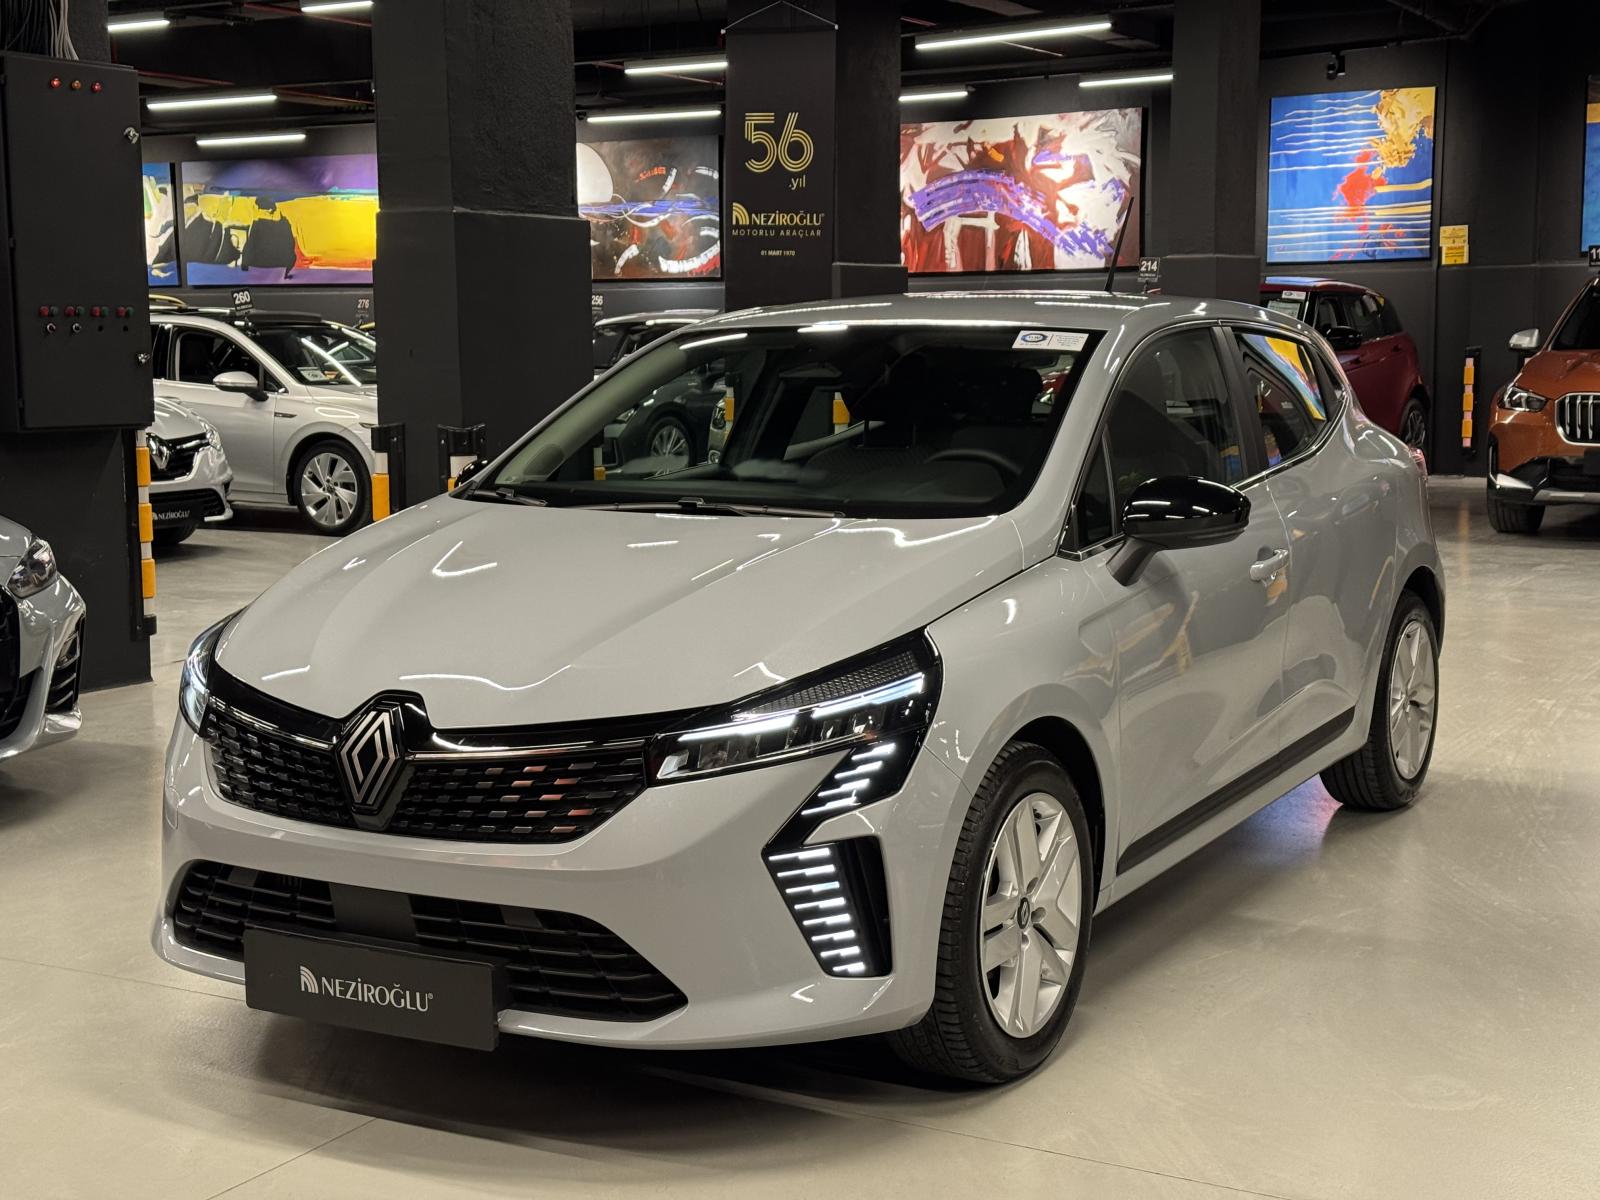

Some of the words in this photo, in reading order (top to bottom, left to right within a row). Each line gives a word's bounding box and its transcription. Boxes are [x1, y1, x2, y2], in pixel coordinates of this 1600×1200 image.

[745, 112, 814, 172] 56
[732, 228, 775, 237] MOTORLU
[779, 229, 822, 239] ARAÇLAR
[1140, 260, 1158, 272] 214
[233, 291, 251, 305] 260
